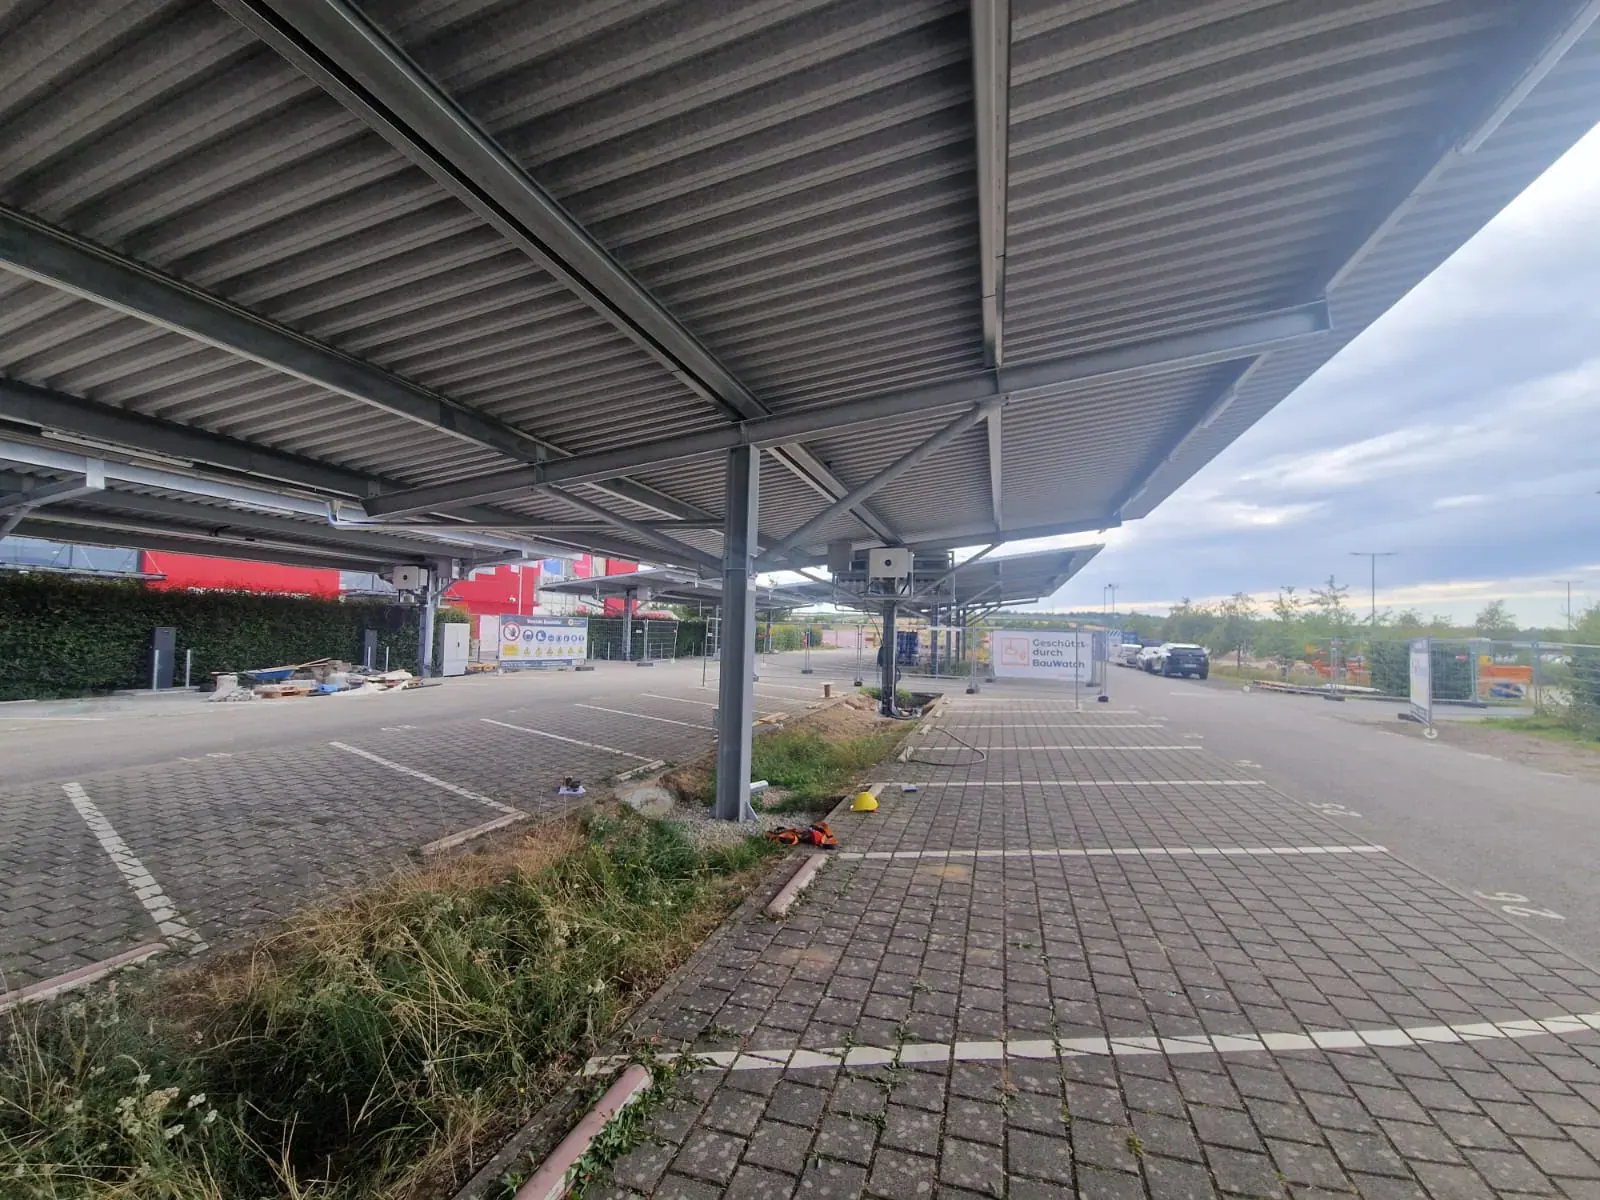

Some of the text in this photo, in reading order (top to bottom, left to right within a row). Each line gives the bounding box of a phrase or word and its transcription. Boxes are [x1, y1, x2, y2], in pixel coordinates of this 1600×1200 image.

[1032, 638, 1085, 648] Geschützt
[1032, 648, 1063, 657] durch
[1032, 658, 1086, 669] BauWatch
